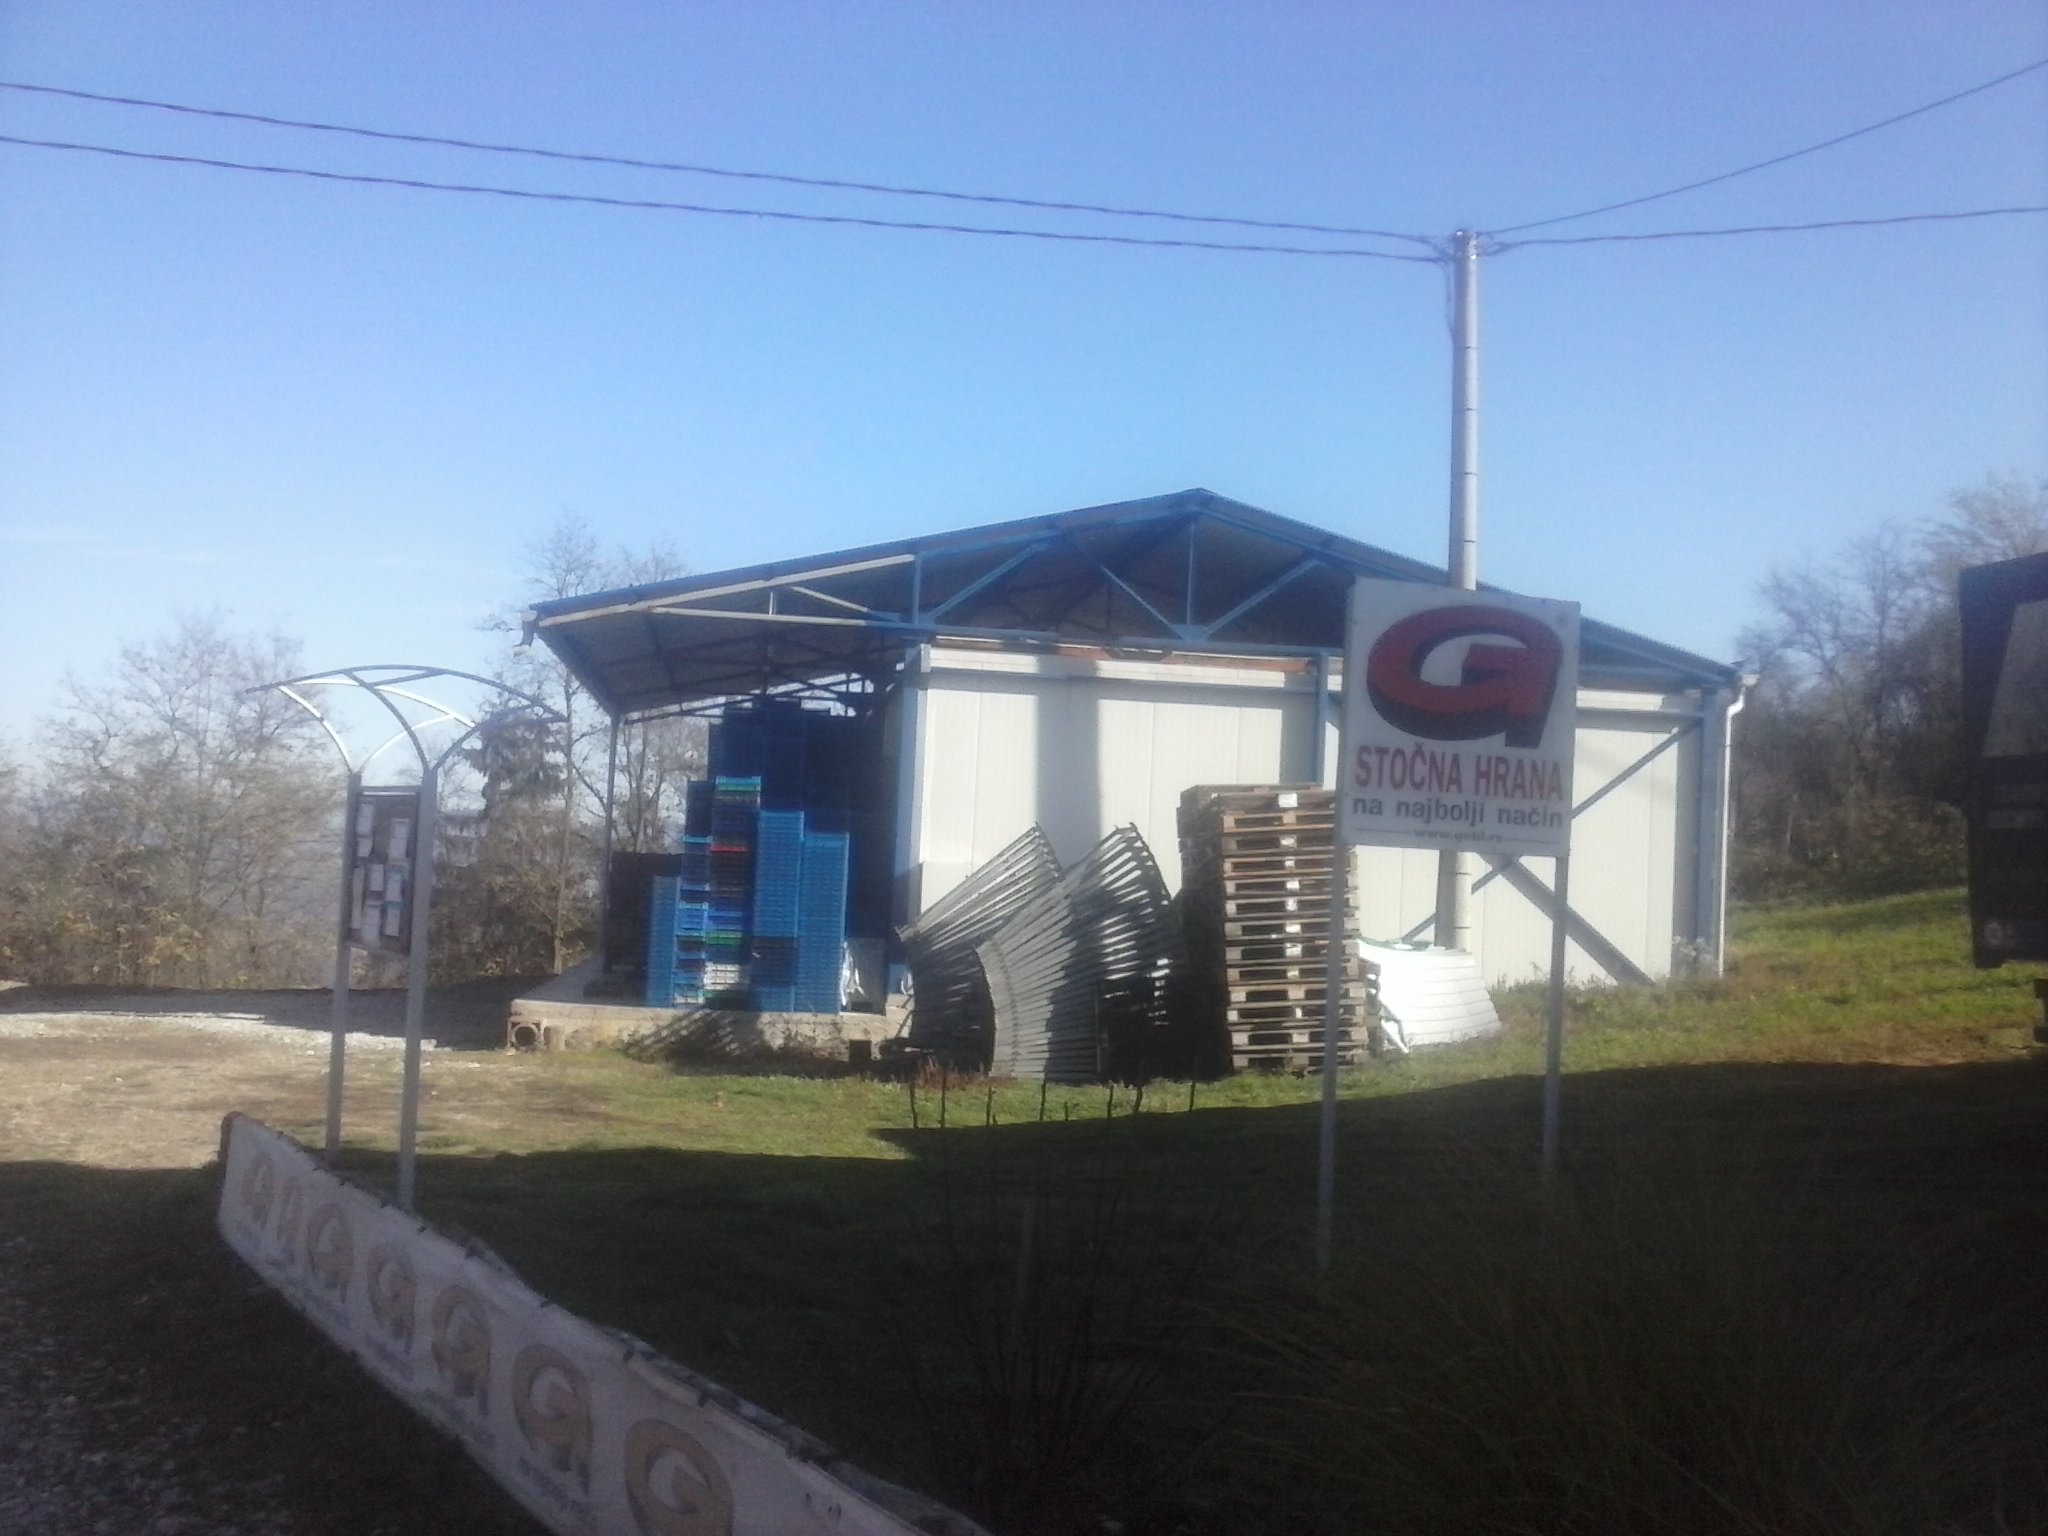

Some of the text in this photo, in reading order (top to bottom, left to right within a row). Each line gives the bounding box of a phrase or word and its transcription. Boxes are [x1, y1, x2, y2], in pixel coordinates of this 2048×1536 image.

[1355, 742, 1564, 801] STOČNA HRANA
[1352, 797, 1564, 829] na najbolji način
